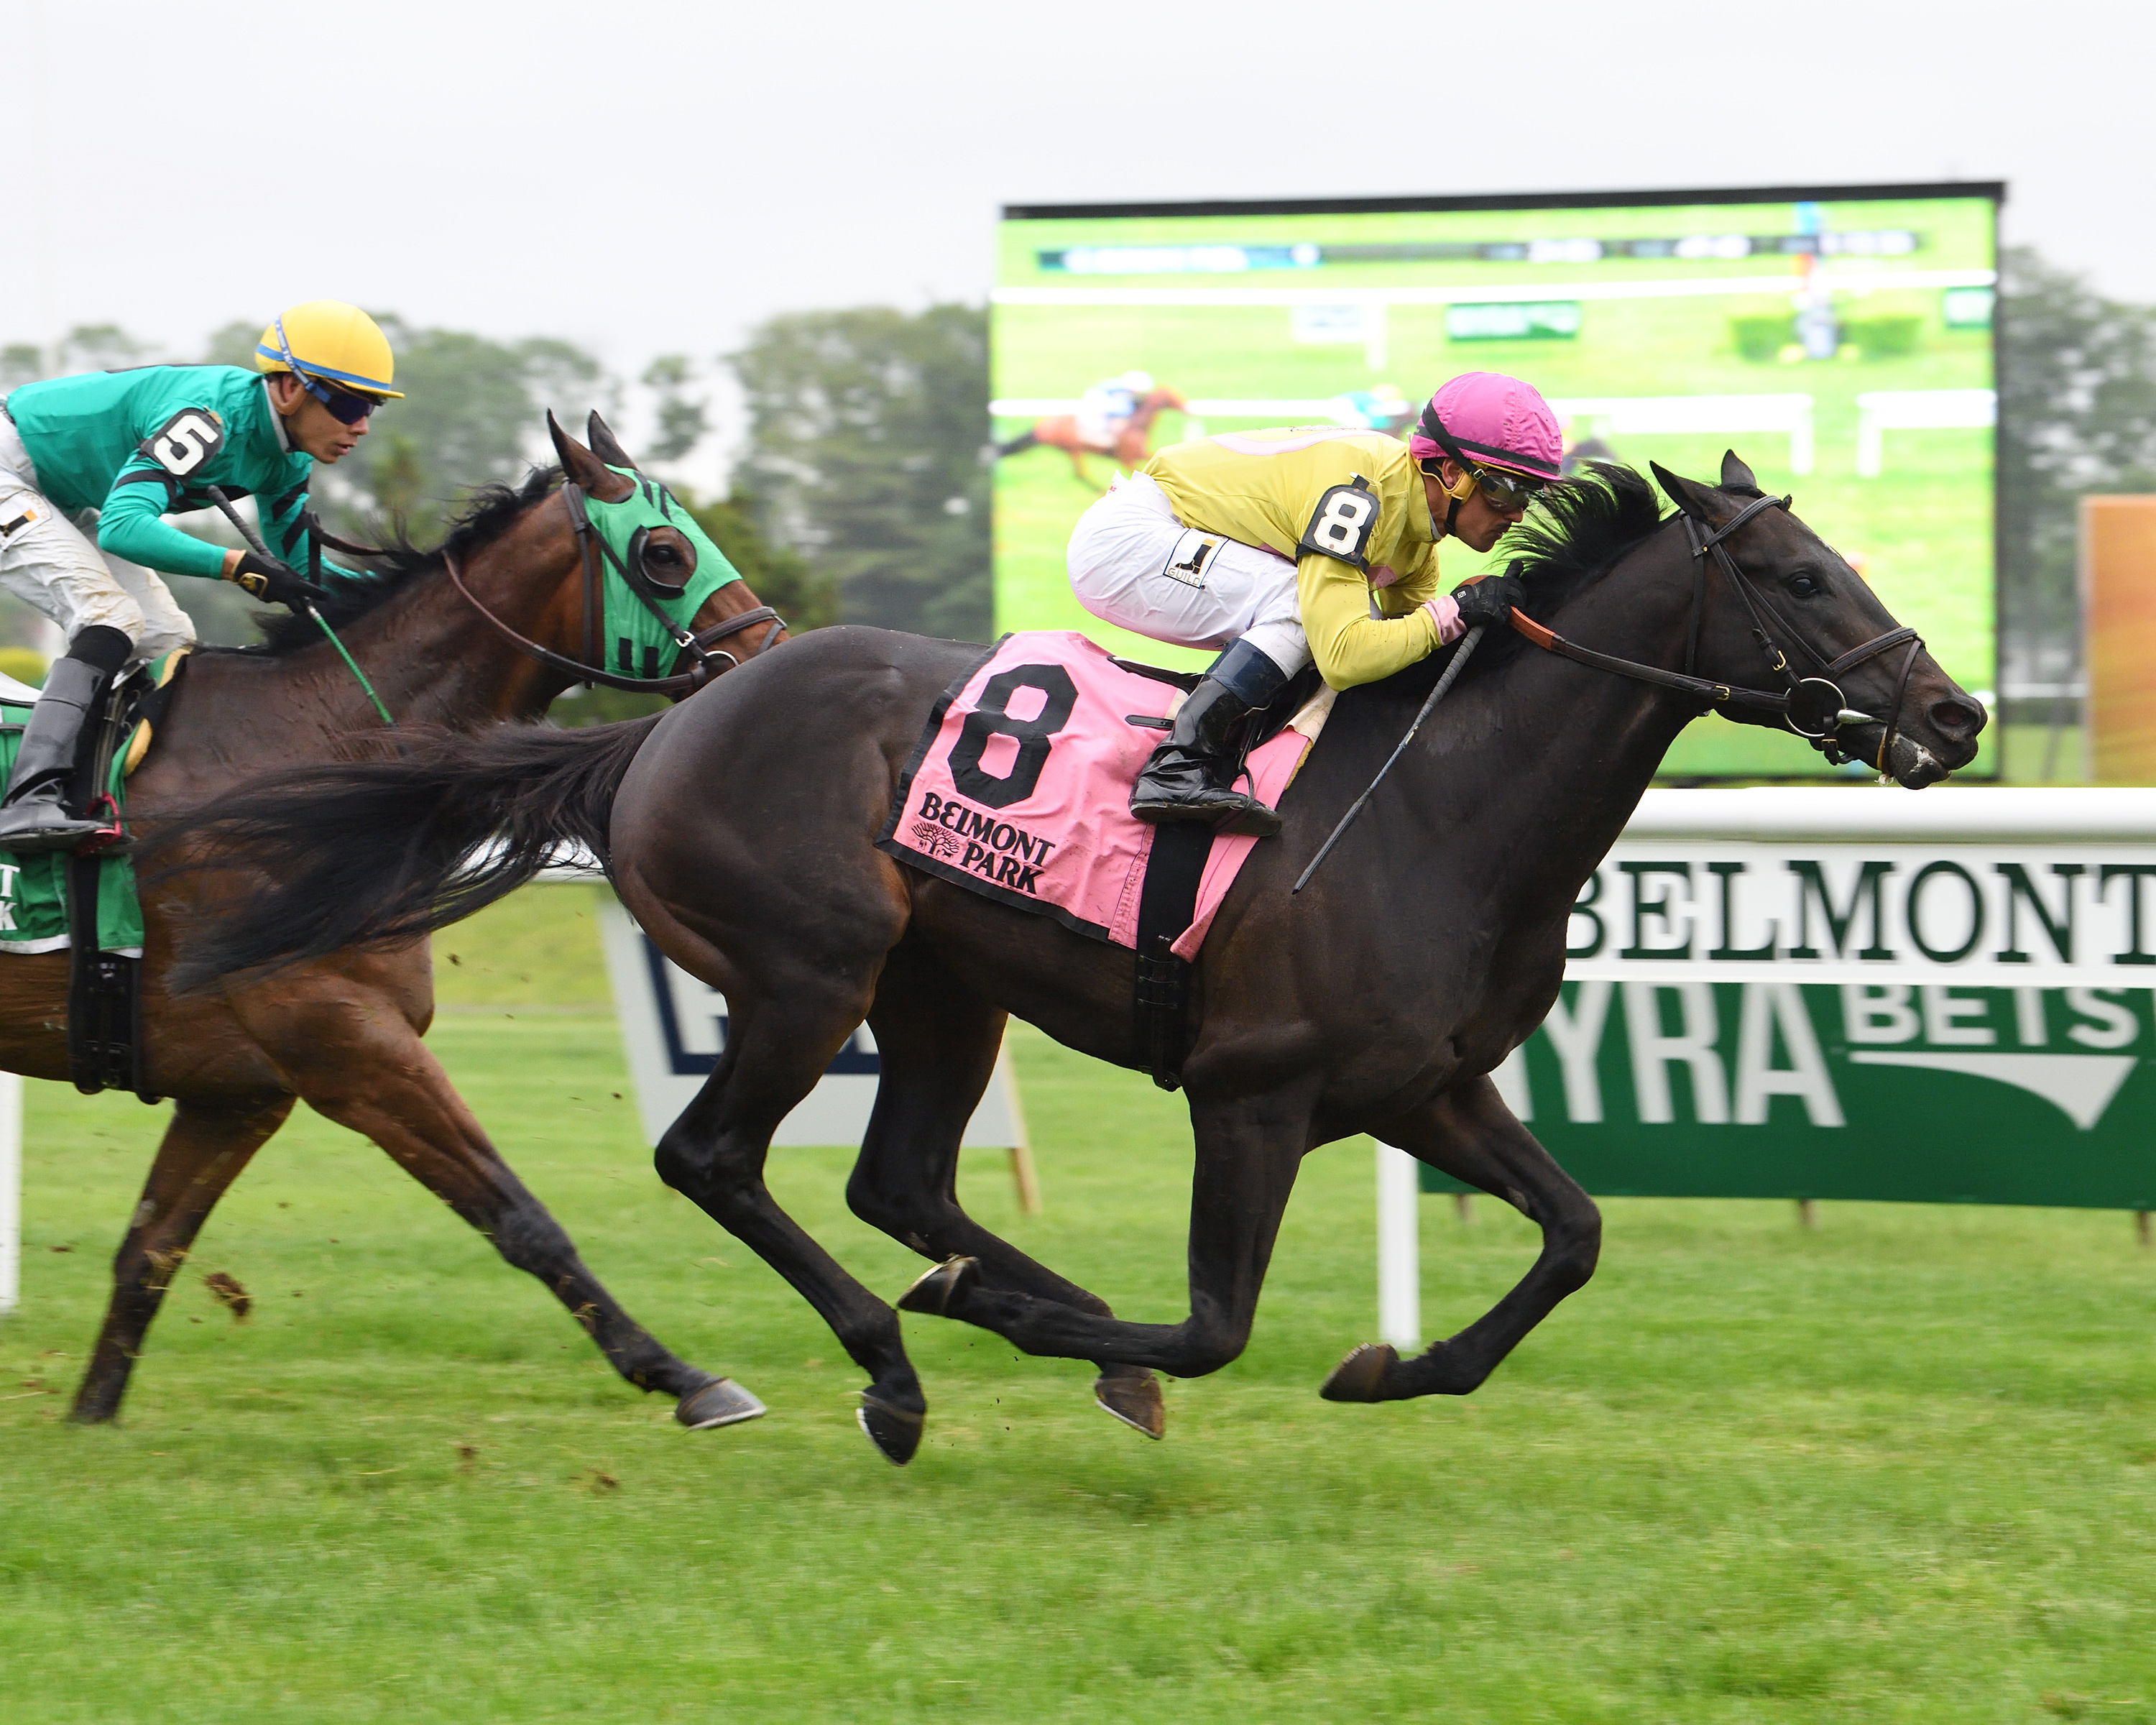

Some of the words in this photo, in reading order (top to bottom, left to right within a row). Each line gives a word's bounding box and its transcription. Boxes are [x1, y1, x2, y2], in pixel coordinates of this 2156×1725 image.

[153, 414, 219, 476] 5
[1313, 487, 1372, 556] 8
[1167, 567, 1201, 586] GUILD
[947, 664, 1079, 809] 8
[918, 792, 1056, 867] BELMONT
[959, 842, 1044, 895] PARK
[1566, 861, 2156, 965] BELMONT
[1488, 981, 1846, 1126] YRA
